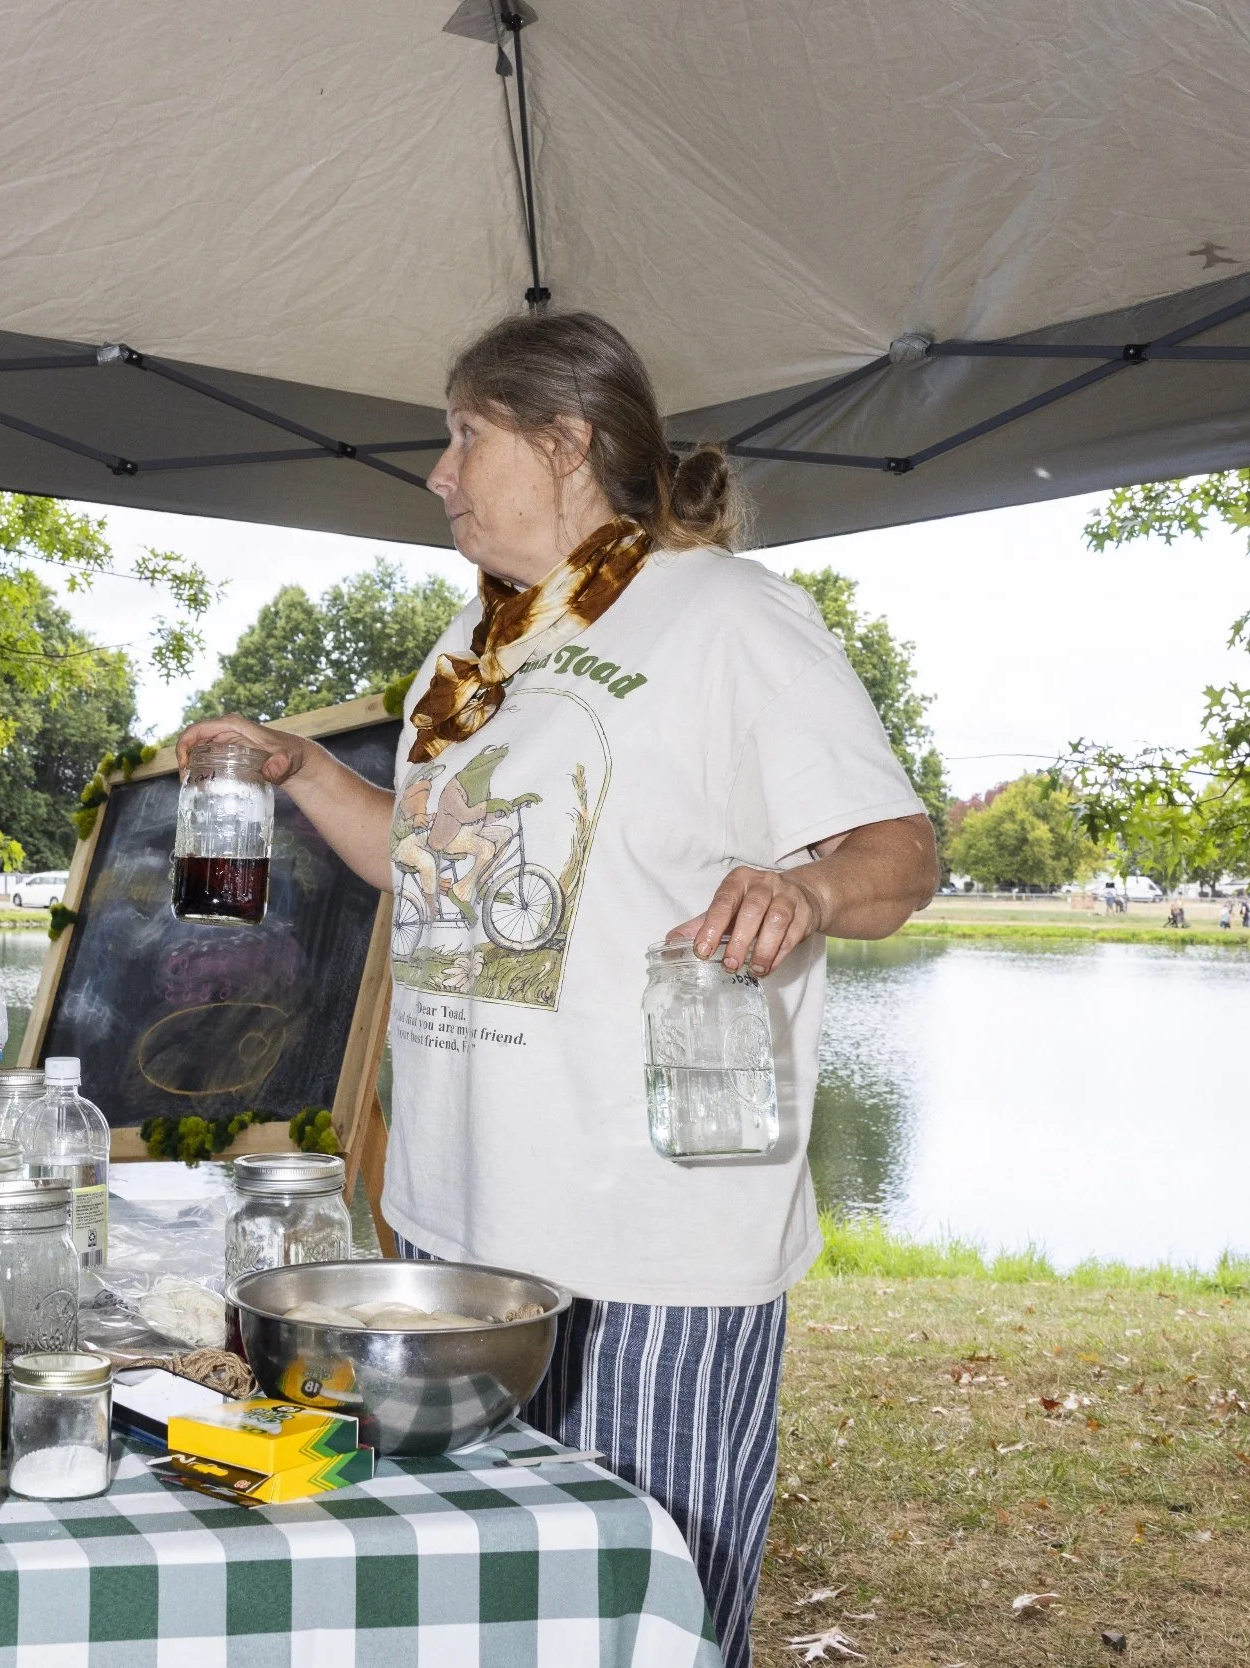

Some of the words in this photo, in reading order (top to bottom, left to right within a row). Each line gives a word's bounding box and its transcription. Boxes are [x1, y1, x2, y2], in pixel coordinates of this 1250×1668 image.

[554, 645, 648, 700] Toad
[416, 1001, 437, 1017] Dear
[418, 1019, 434, 1031] you
[438, 1022, 455, 1034] are
[480, 1027, 527, 1046] friend.
[425, 1035, 460, 1053] friend,
